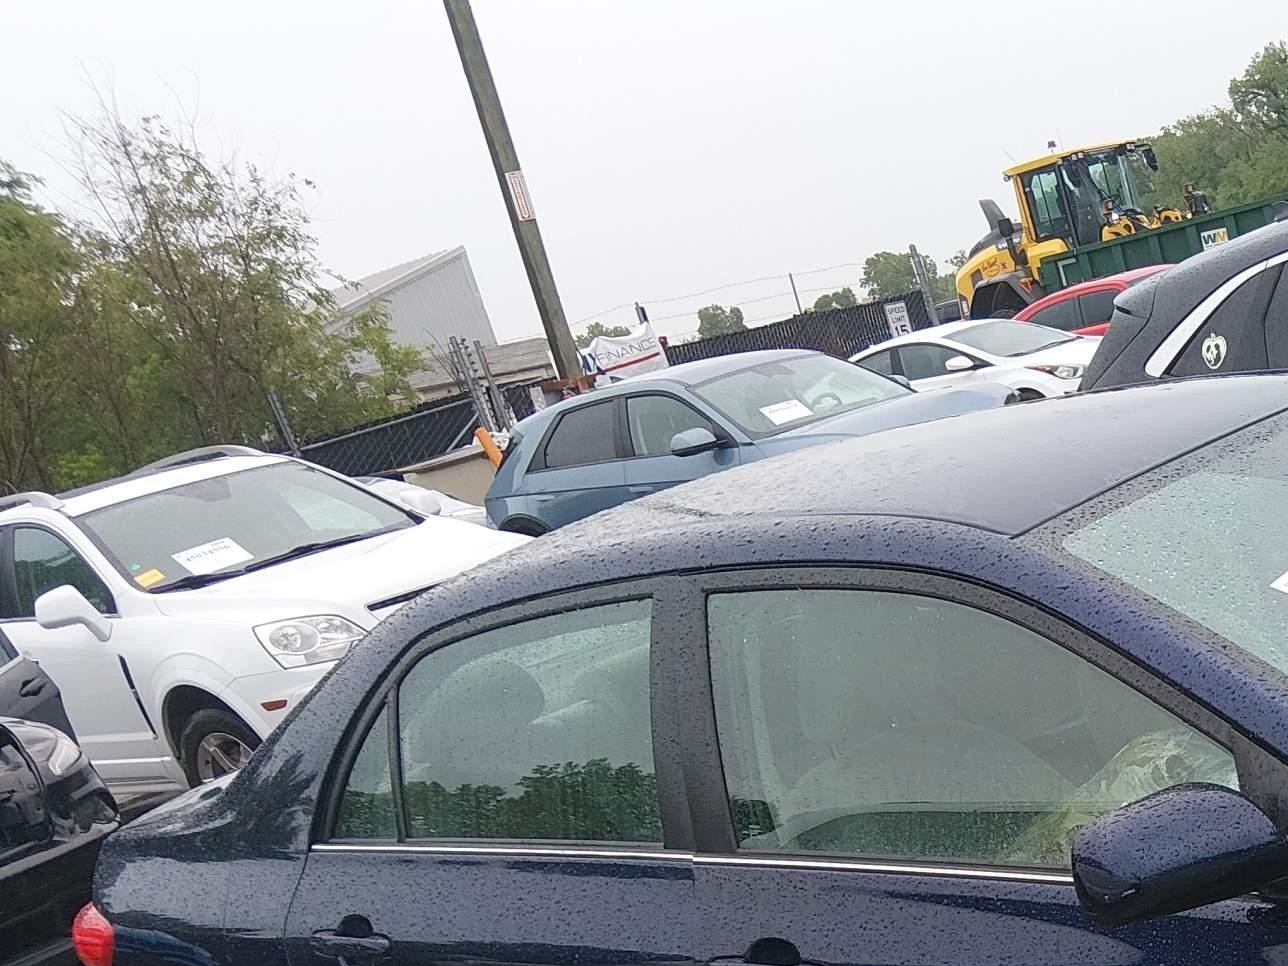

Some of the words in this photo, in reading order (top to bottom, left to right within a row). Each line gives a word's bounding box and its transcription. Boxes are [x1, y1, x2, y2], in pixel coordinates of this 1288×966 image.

[887, 306, 905, 314] SPEED
[892, 315, 905, 323] LIMIT
[895, 325, 910, 336] 15
